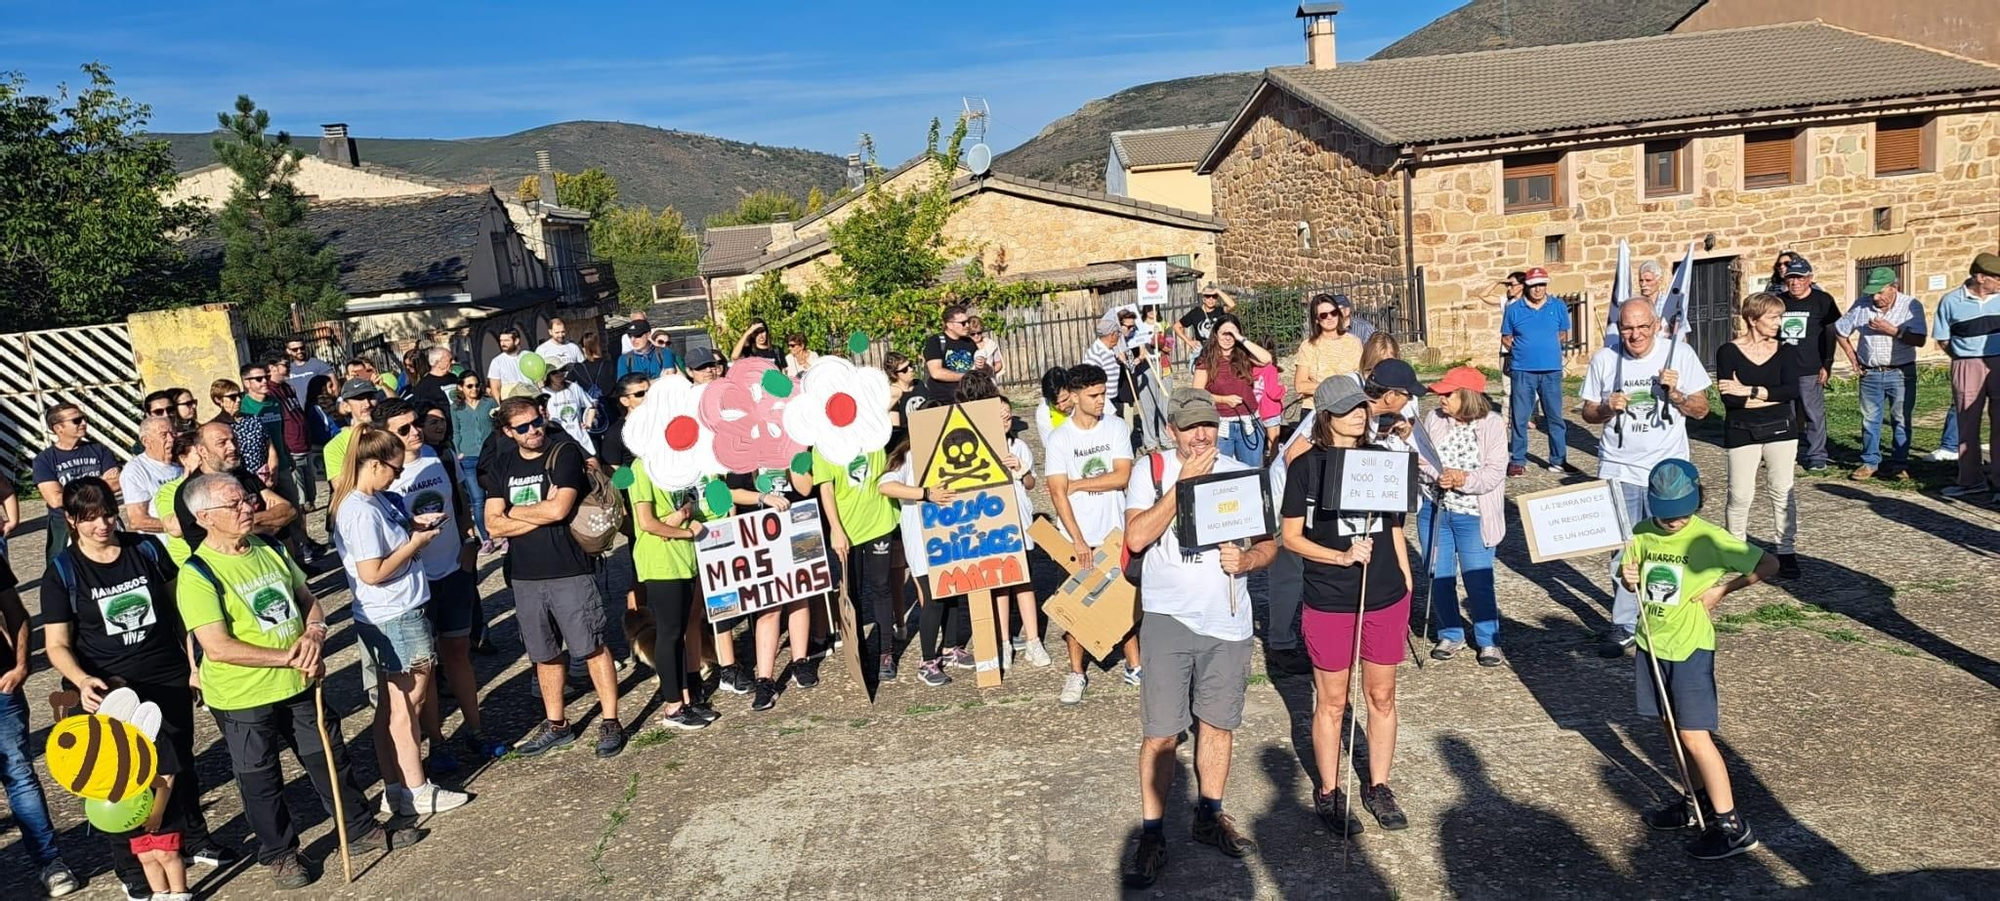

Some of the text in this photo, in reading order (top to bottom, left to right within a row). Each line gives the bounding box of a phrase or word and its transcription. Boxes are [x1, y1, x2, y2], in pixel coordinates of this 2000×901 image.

[1631, 423, 1649, 433] VIVE
[1073, 444, 1111, 458] NAHARROS
[56, 458, 97, 472] PREMIUM
[401, 476, 443, 494] NAHARROS
[1351, 473, 1374, 483] NOOO
[1350, 489, 1400, 500] EN EL AIRE
[921, 491, 1005, 529] POLVO
[1218, 501, 1239, 513] STOP
[1540, 502, 1551, 511] LA
[1551, 498, 1580, 510] TIERRA
[1580, 495, 1593, 504] NO
[1548, 511, 1600, 527] UN RECURSO
[738, 512, 782, 549] NO
[1553, 526, 1607, 542] ES UN HOGAR
[1181, 549, 1204, 564] VIVE
[705, 547, 774, 592] MAS
[936, 555, 1024, 597] MATA
[91, 575, 148, 600] NAHARROS
[234, 570, 283, 595] NAHARROS
[738, 560, 831, 612] MINAS
[122, 630, 146, 646] VIVE
